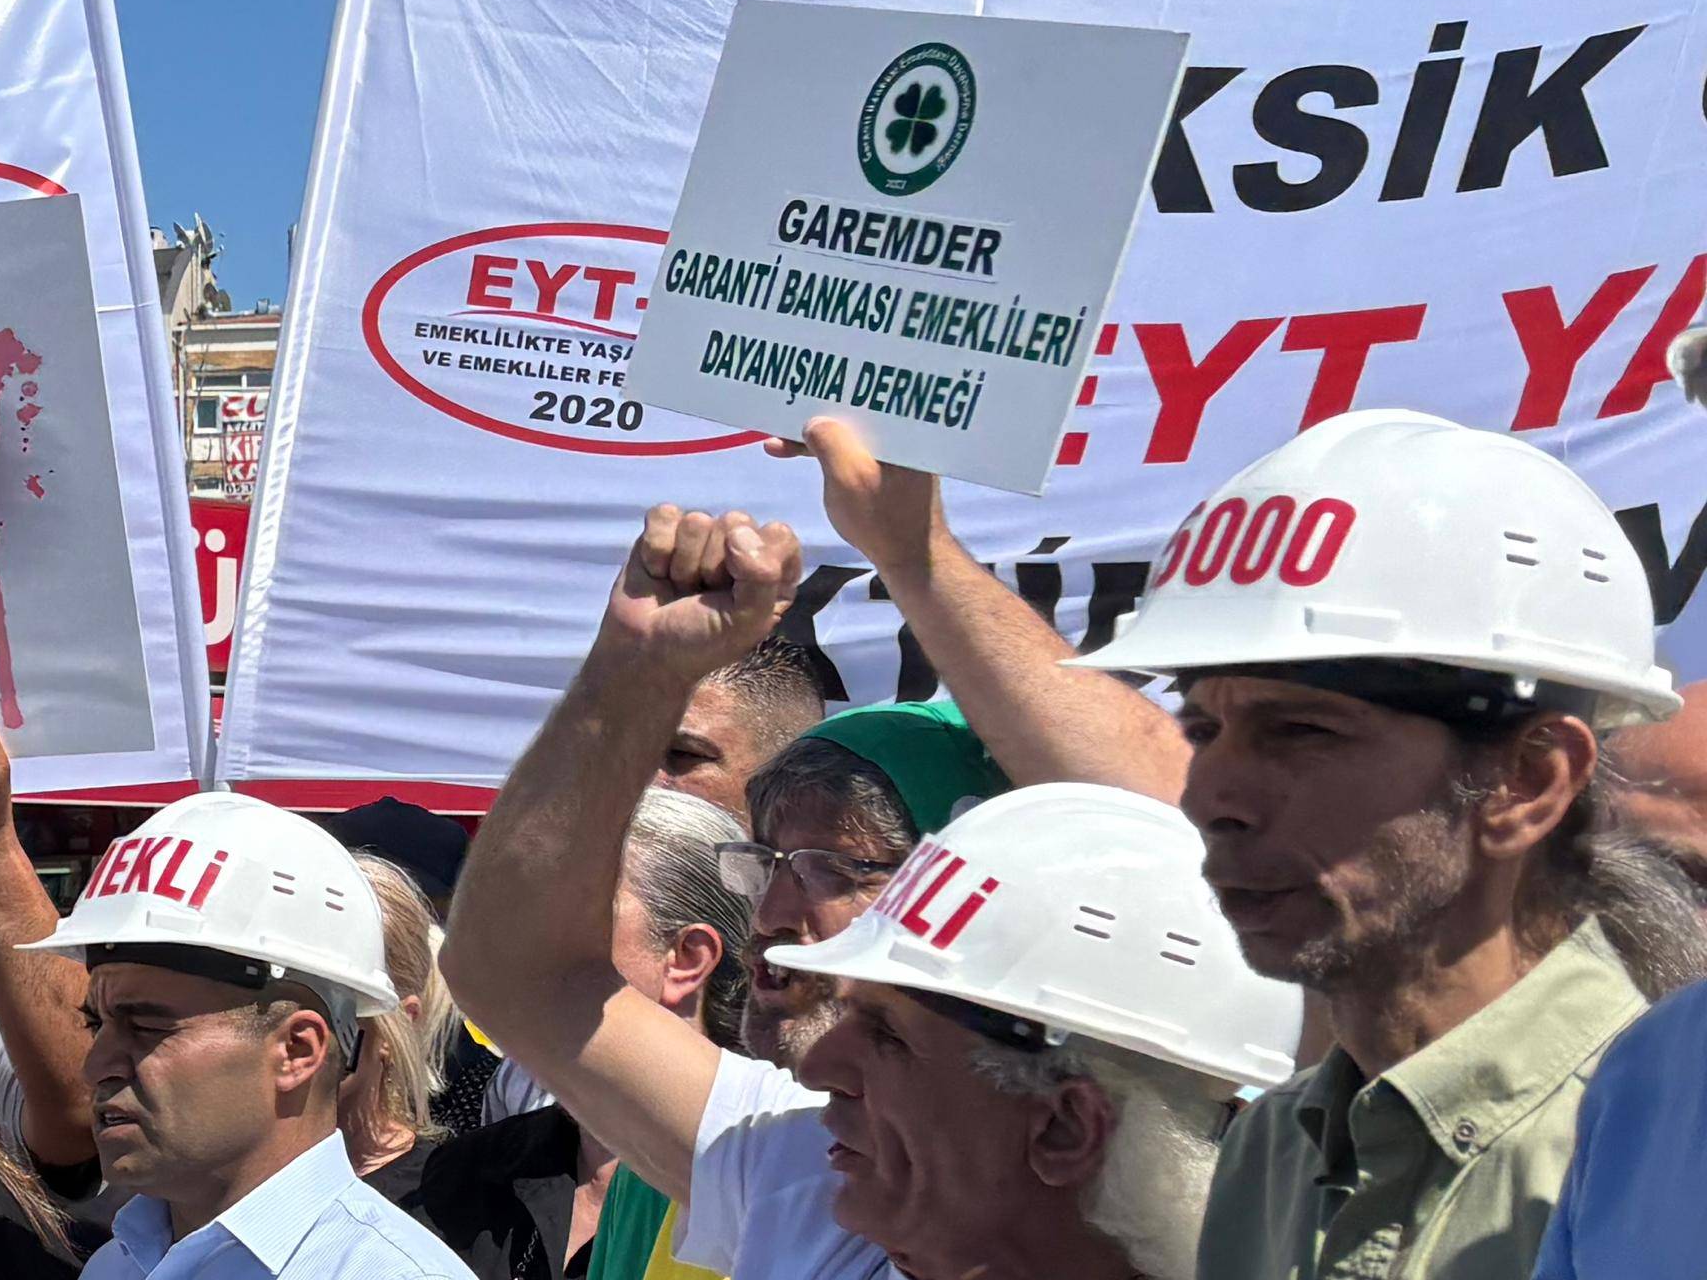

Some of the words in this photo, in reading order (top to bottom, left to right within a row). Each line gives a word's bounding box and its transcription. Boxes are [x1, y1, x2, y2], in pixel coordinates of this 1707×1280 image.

[777, 198, 1003, 276] GAREMDER
[665, 248, 784, 311] GARANTİ
[776, 268, 902, 335] BANKASI
[900, 291, 1088, 367] EMEKLİLERİ
[414, 322, 572, 354] EMEKLİLİKTE
[422, 350, 452, 367] VE
[458, 354, 591, 384] EMEKLİLER
[699, 329, 849, 405] DAYANIŞMA
[850, 361, 987, 431] DERNEĞİ
[529, 391, 644, 432] 2020
